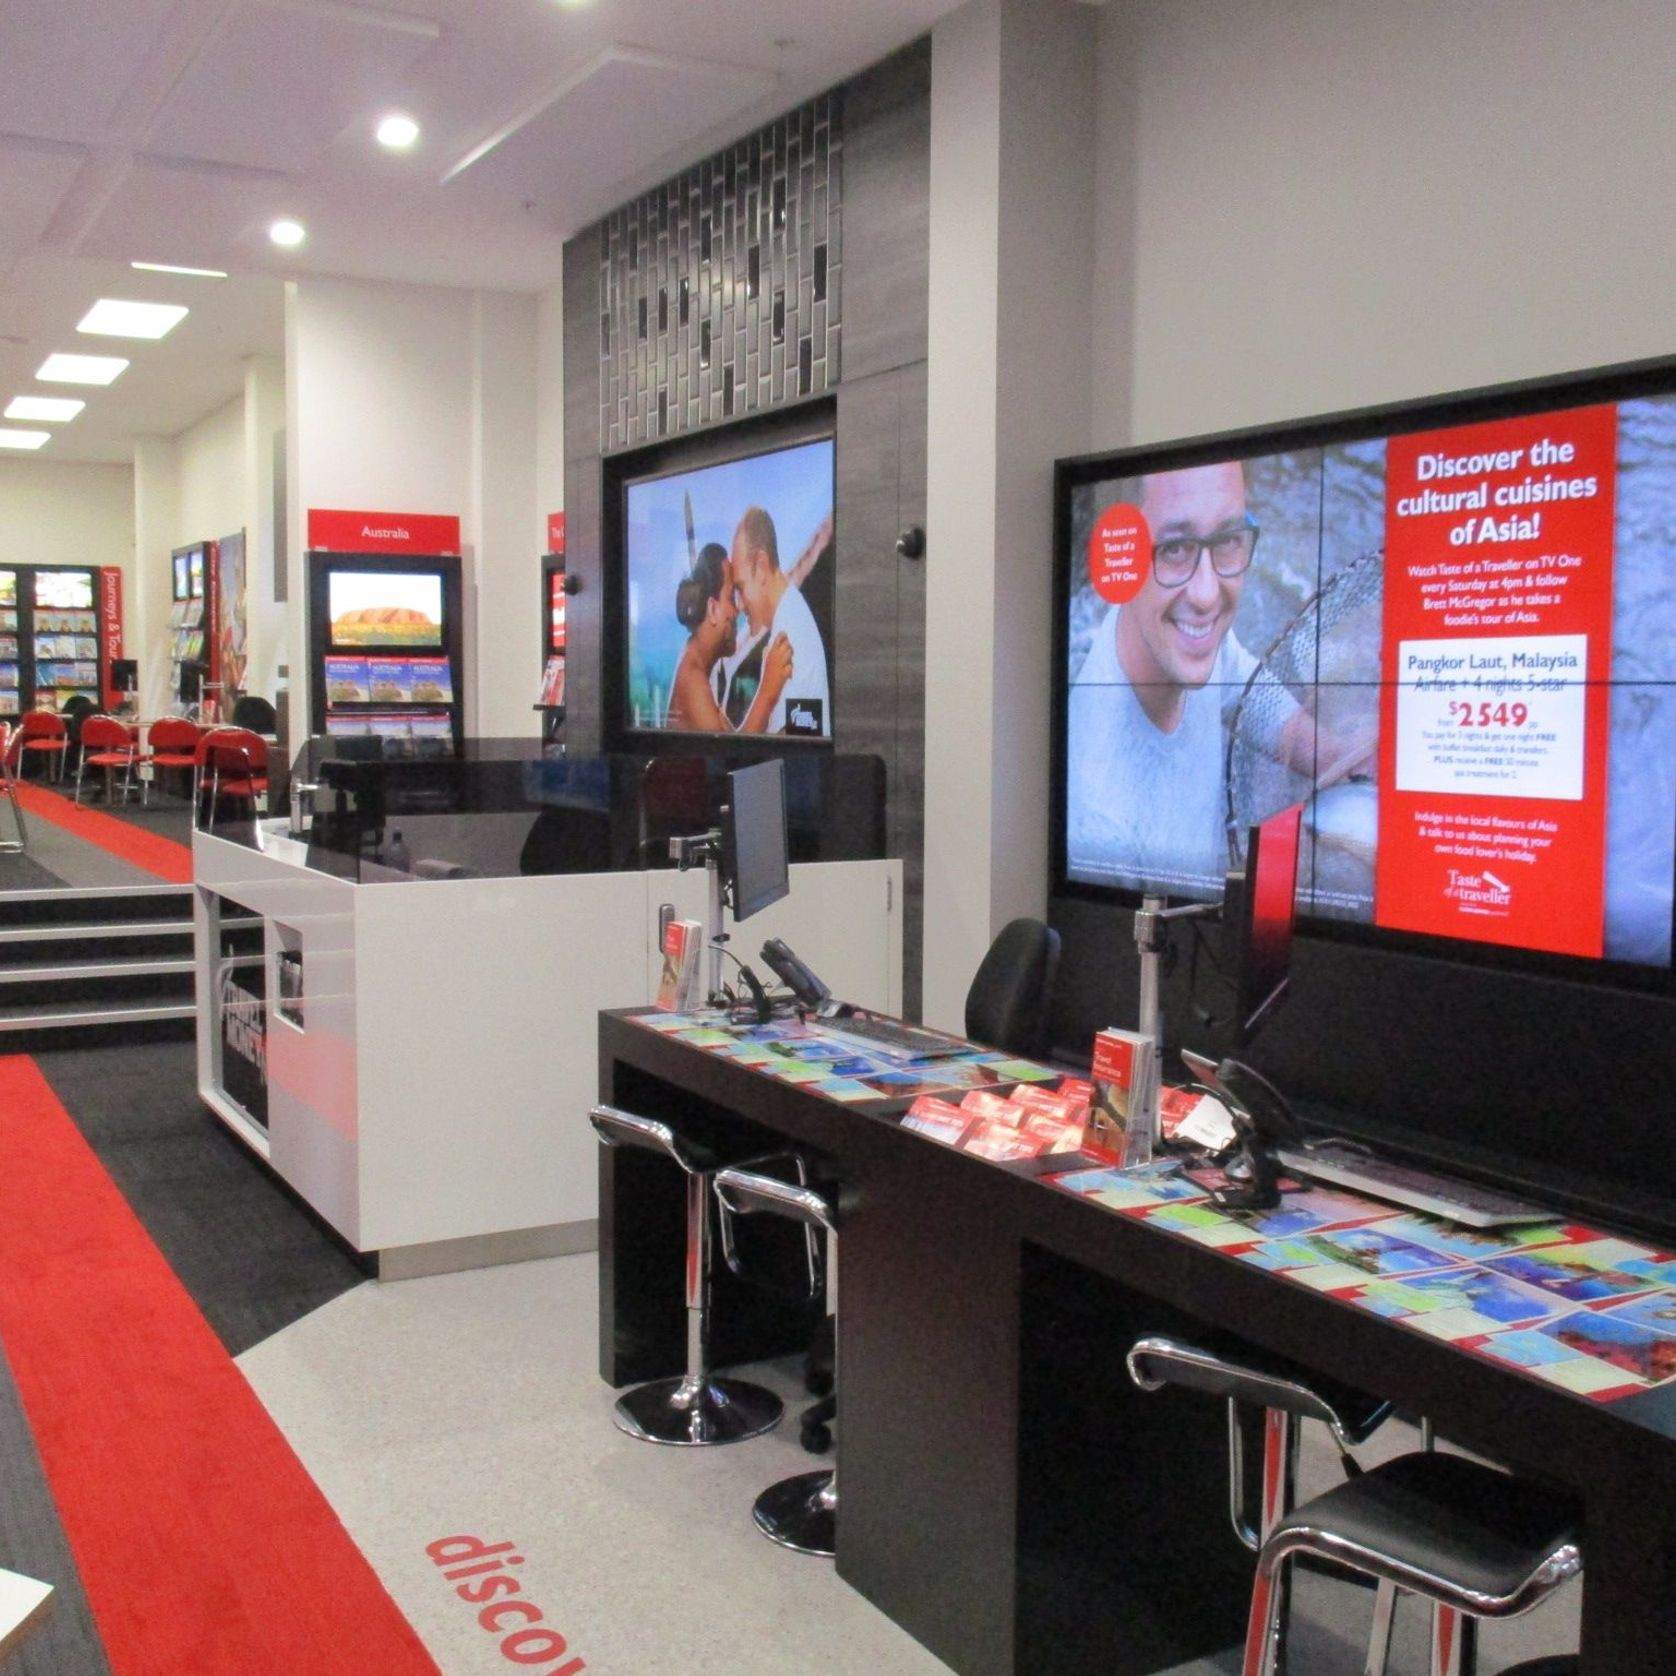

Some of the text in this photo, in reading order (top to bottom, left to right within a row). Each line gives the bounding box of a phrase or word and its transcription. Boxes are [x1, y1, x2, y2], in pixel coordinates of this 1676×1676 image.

[1417, 438, 1574, 481] Discover the
[1397, 475, 1597, 518] cultural cuisines
[361, 525, 409, 539] Australia
[1450, 512, 1540, 546] of Asia!
[1408, 555, 1582, 577] Watch Taste of a Traveller on TV One
[1111, 572, 1122, 581] TV
[1421, 574, 1568, 594] every Saturday at 4pm & follow
[1424, 593, 1561, 610] Brett McGregor as he takes a
[104, 572, 121, 664] Journeys & Tour
[1482, 614, 1502, 624] tour
[1505, 611, 1516, 623] of
[1408, 651, 1578, 673] Pangkor Laut, Malaysia
[1415, 675, 1456, 692] Airfare
[1473, 675, 1482, 692] 4
[1485, 675, 1523, 696] nights
[1536, 733, 1556, 741] FREE
[1484, 757, 1503, 765] FREE
[1415, 811, 1444, 824] Indulge
[1445, 815, 1453, 823] in
[1455, 815, 1469, 825] the
[1470, 815, 1491, 827] local
[1492, 816, 1525, 829] flavours
[1527, 819, 1537, 830] of
[1419, 826, 1552, 848] & talk to us about planning your
[1435, 844, 1452, 853] own
[1454, 844, 1474, 856] food
[1448, 869, 1482, 888] Taste
[1459, 888, 1511, 905] traveller
